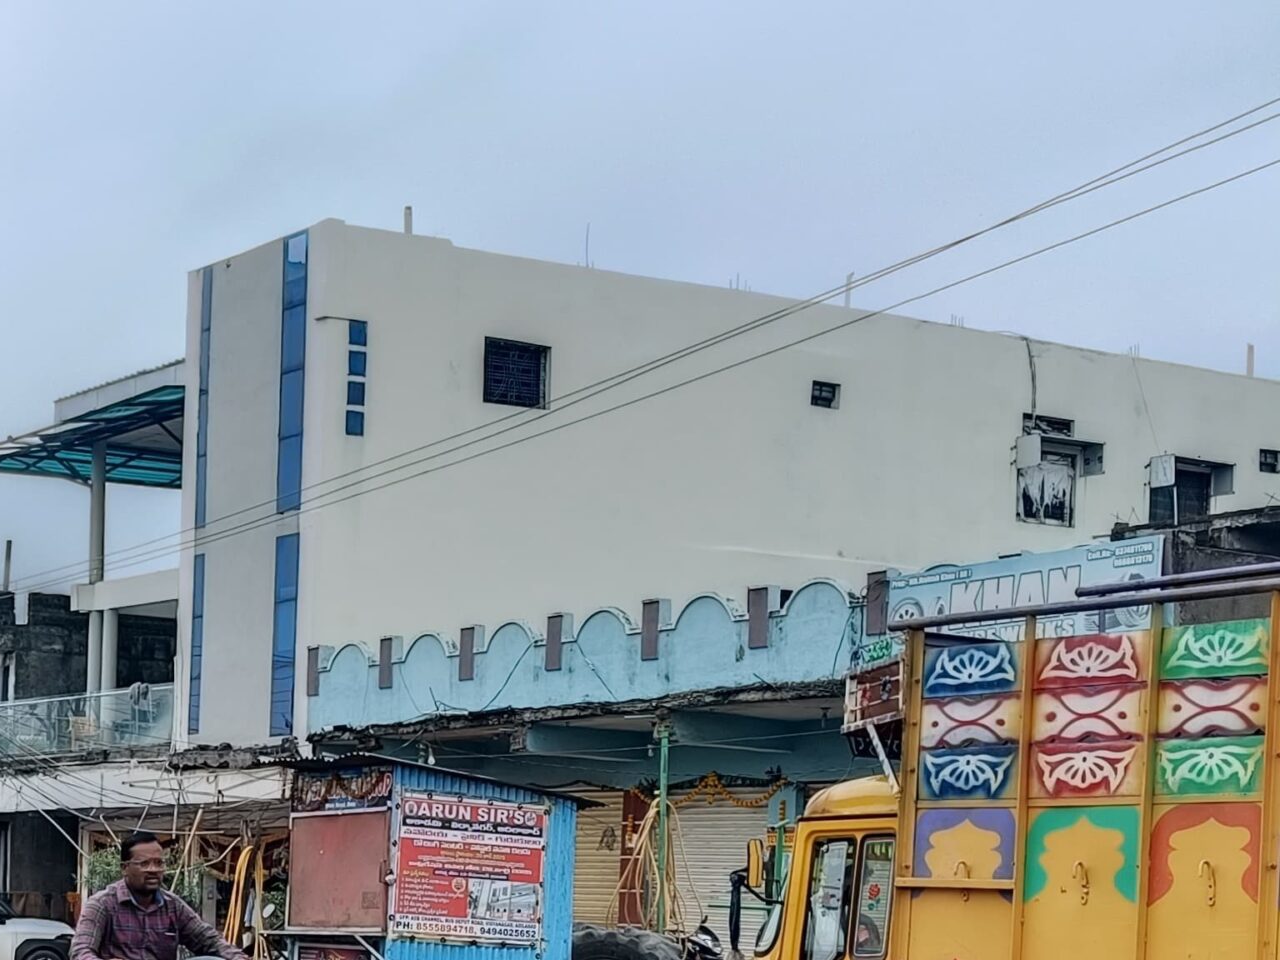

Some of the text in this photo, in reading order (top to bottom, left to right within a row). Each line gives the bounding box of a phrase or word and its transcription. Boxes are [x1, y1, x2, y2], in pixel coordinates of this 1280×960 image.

[949, 565, 1081, 631] KHAN
[417, 803, 525, 826] ARUN SIR'S
[396, 921, 413, 930] PH:
